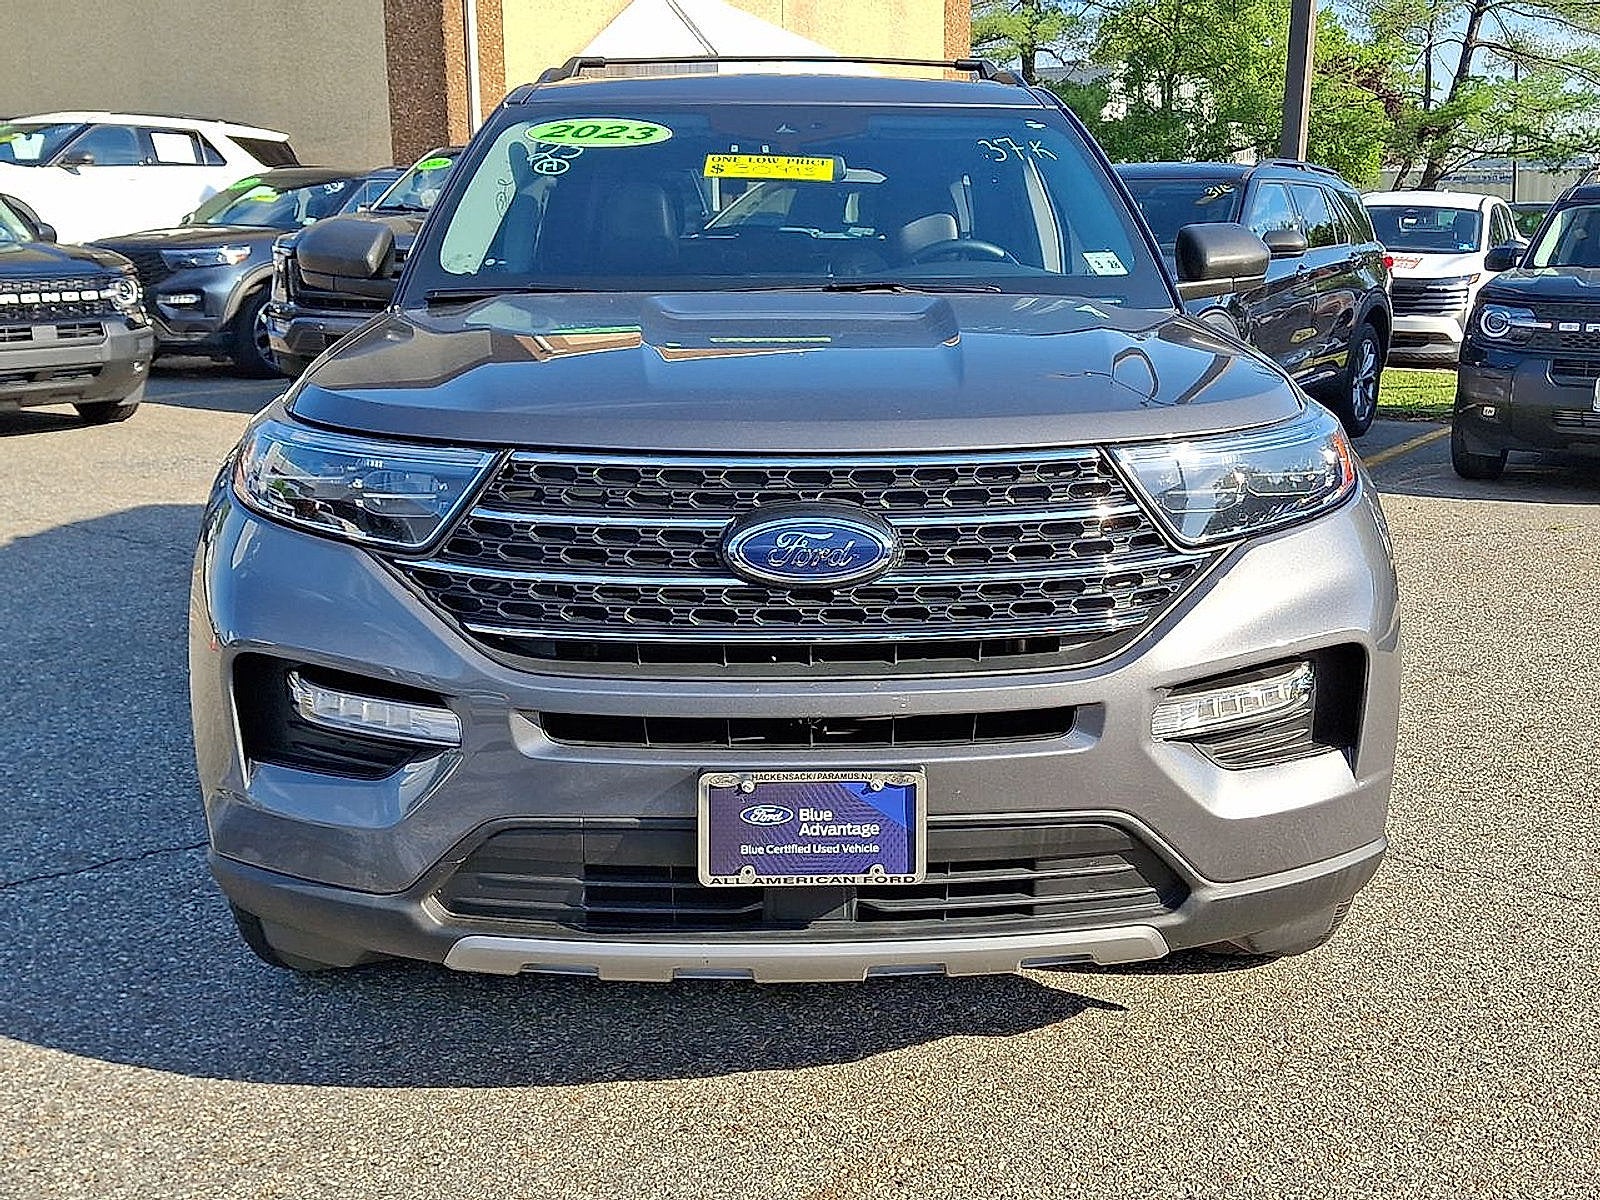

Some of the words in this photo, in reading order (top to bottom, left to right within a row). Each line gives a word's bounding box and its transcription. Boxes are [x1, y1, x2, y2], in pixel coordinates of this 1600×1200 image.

[540, 124, 658, 140] 2023
[711, 155, 741, 164] ONE
[748, 156, 781, 165] LOW
[786, 158, 829, 167] PRICE
[768, 531, 855, 567] Ford
[750, 808, 784, 822] Ford
[799, 808, 833, 821] Blue
[799, 822, 880, 838] Advantage
[740, 843, 765, 855] Blue
[766, 843, 812, 855] Certified
[812, 843, 840, 854] Used
[842, 842, 880, 854] Vehicle
[710, 876, 743, 886] ALL
[752, 875, 857, 886] AMERICAN
[863, 874, 916, 884] FORD
